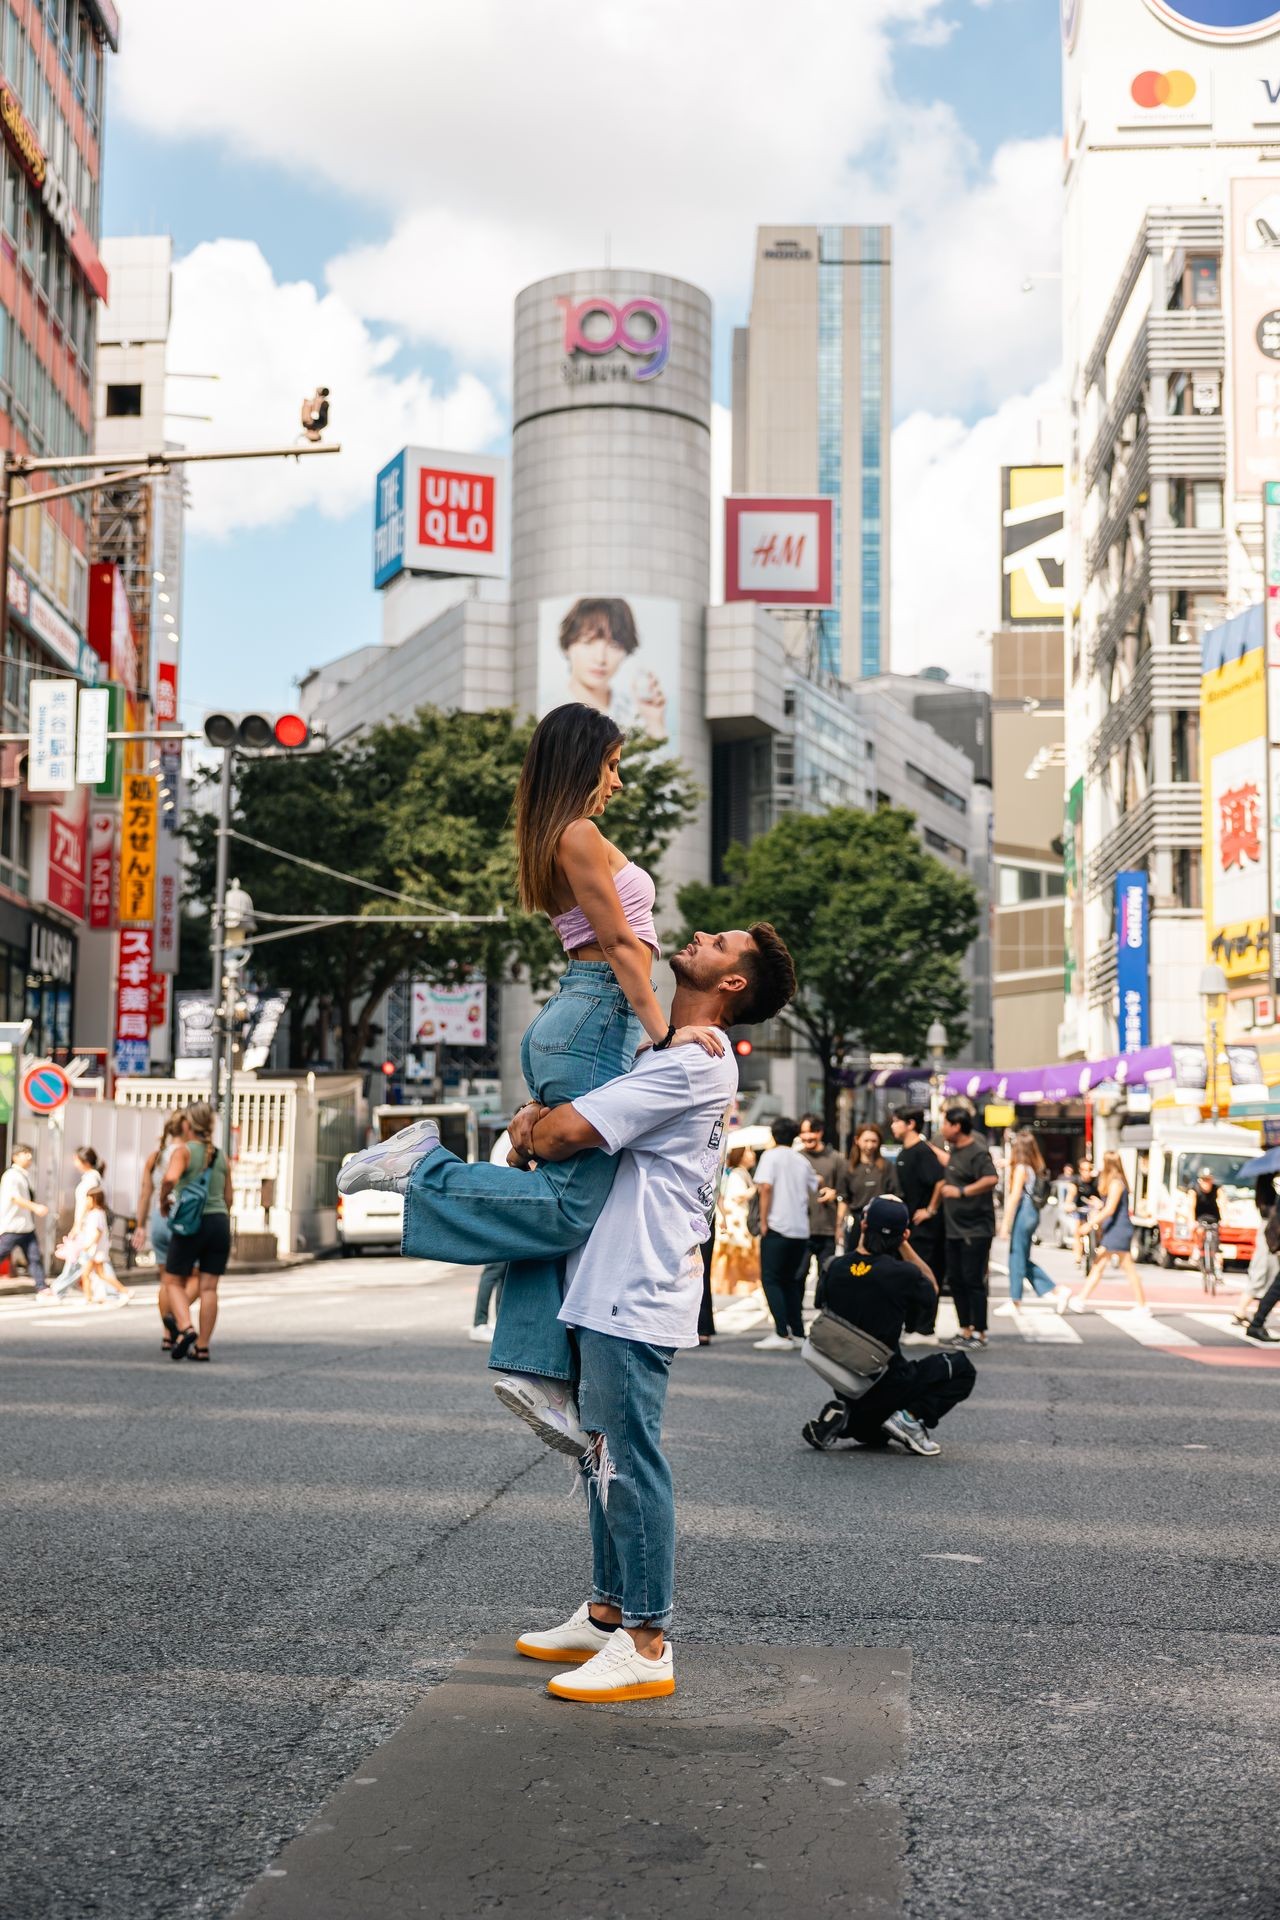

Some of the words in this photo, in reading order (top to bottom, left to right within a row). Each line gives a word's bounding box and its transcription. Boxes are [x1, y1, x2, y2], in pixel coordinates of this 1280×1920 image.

[552, 294, 672, 383] 109
[424, 508, 489, 545] QLO
[425, 475, 483, 512] UNI
[128, 778, 152, 878] 処方せん
[30, 923, 73, 985] LUSH
[119, 930, 151, 1039] スギ薬局
